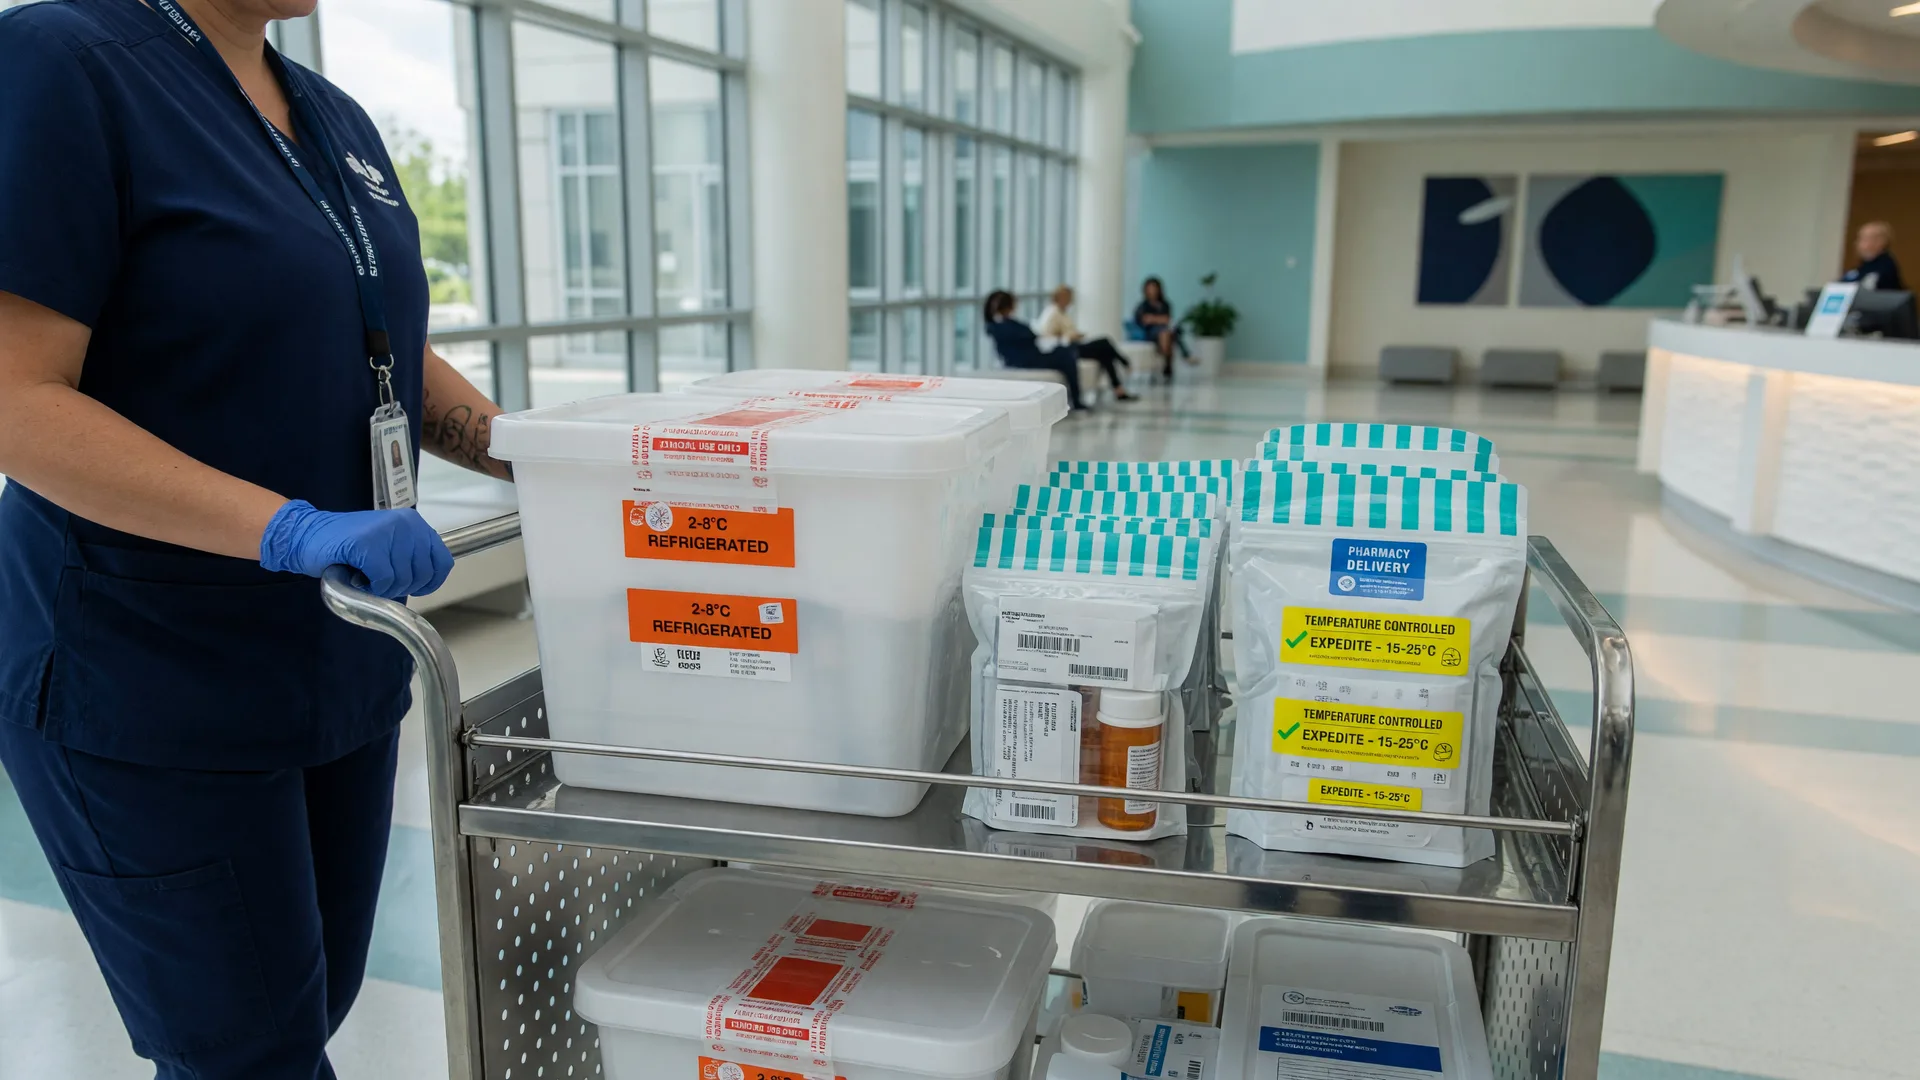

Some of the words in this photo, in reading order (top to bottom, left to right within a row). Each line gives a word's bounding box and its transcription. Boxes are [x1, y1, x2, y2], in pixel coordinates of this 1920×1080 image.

[688, 516, 728, 531] 2-8°C
[648, 534, 769, 553] REFRIGERATED
[1348, 546, 1410, 560] PHARMACY
[1347, 559, 1410, 574] DELIVERY
[691, 603, 731, 618] 2-8°C
[652, 619, 772, 640] REFRIGERATED
[1305, 614, 1381, 631] TEMPERATURE
[1384, 620, 1456, 636] CONTROLLED
[1310, 636, 1373, 652] EXPEDITE
[1386, 642, 1437, 657] 15-25°C
[1303, 708, 1376, 725] TEMPERATURE
[1378, 715, 1443, 730] CONTROLLED
[1302, 729, 1364, 746] EXPEDITE
[1377, 735, 1429, 751] 15-25°C
[1320, 785, 1364, 799] EXPEDITE
[1374, 791, 1410, 803] 15-25°C
